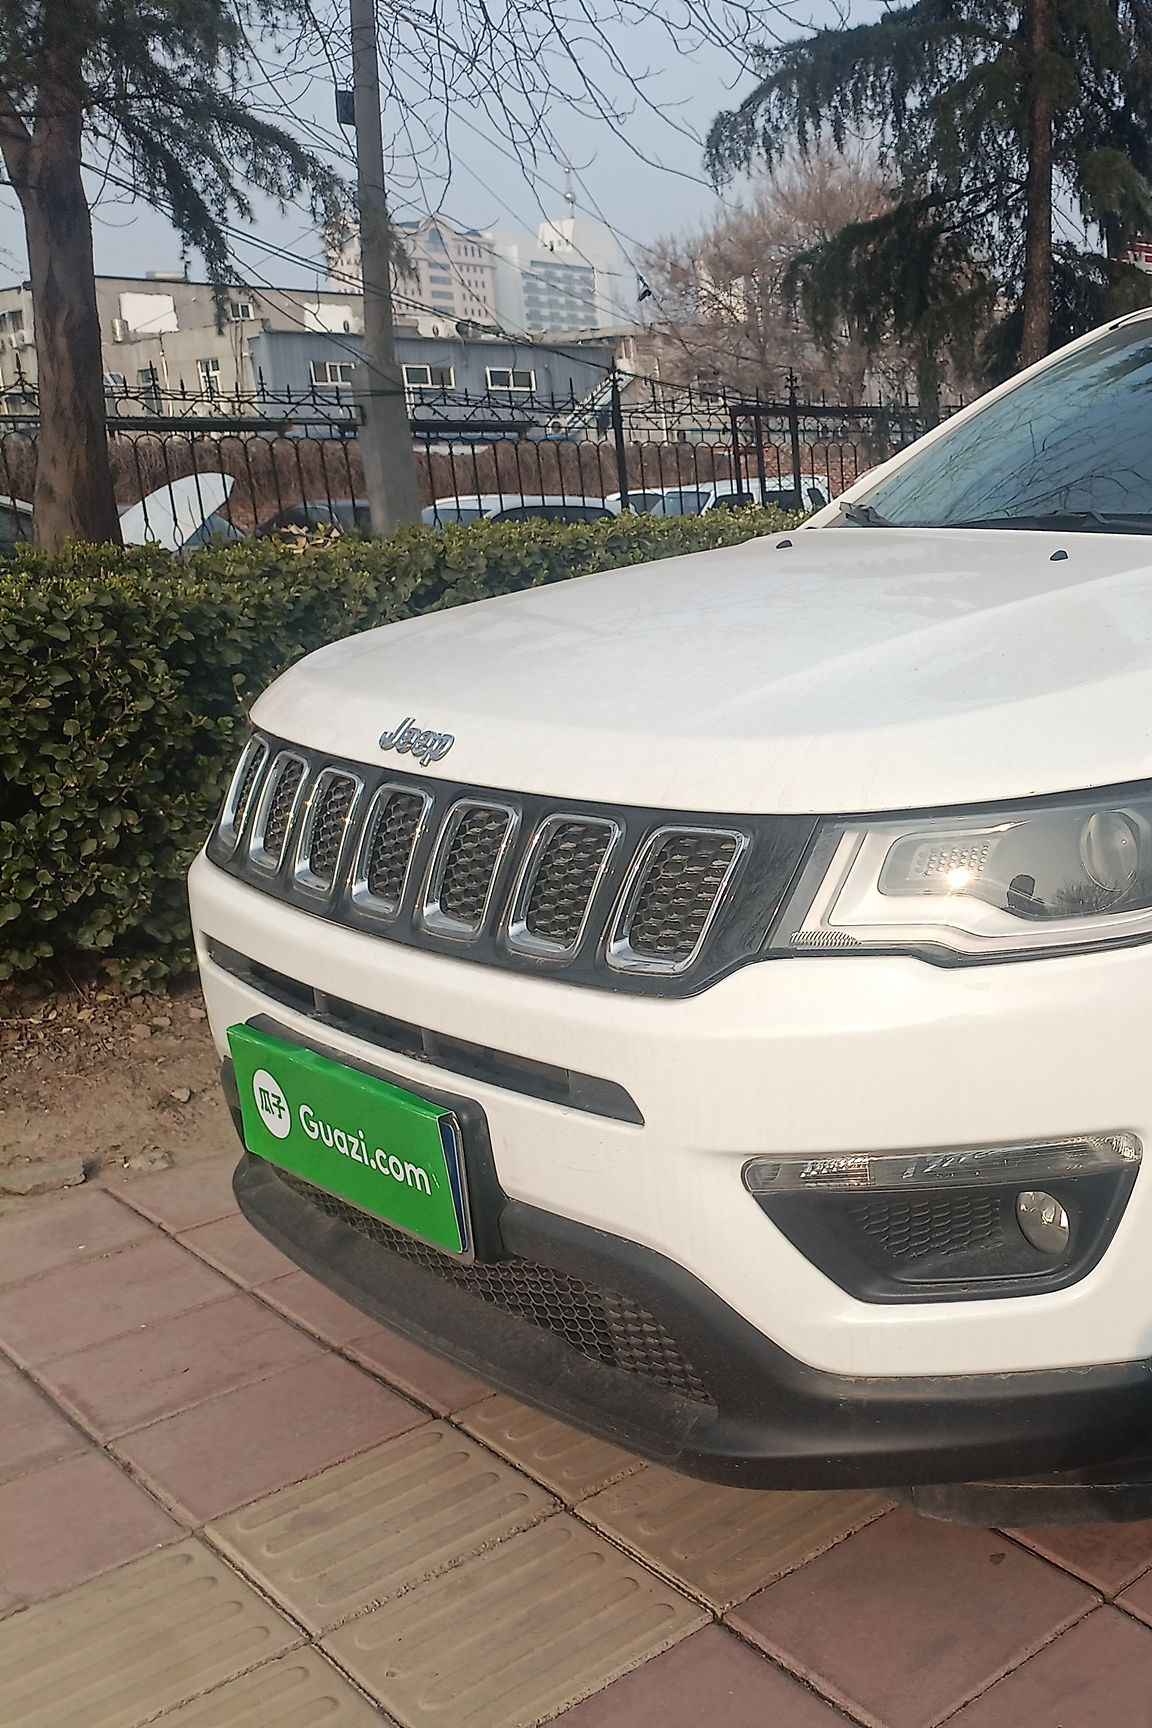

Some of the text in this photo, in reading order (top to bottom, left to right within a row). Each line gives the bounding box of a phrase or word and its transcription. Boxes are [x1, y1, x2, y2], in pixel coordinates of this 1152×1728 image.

[379, 717, 455, 767] Jeep
[258, 1086, 286, 1119] 瓜子
[299, 1104, 432, 1195] Guazi.com
